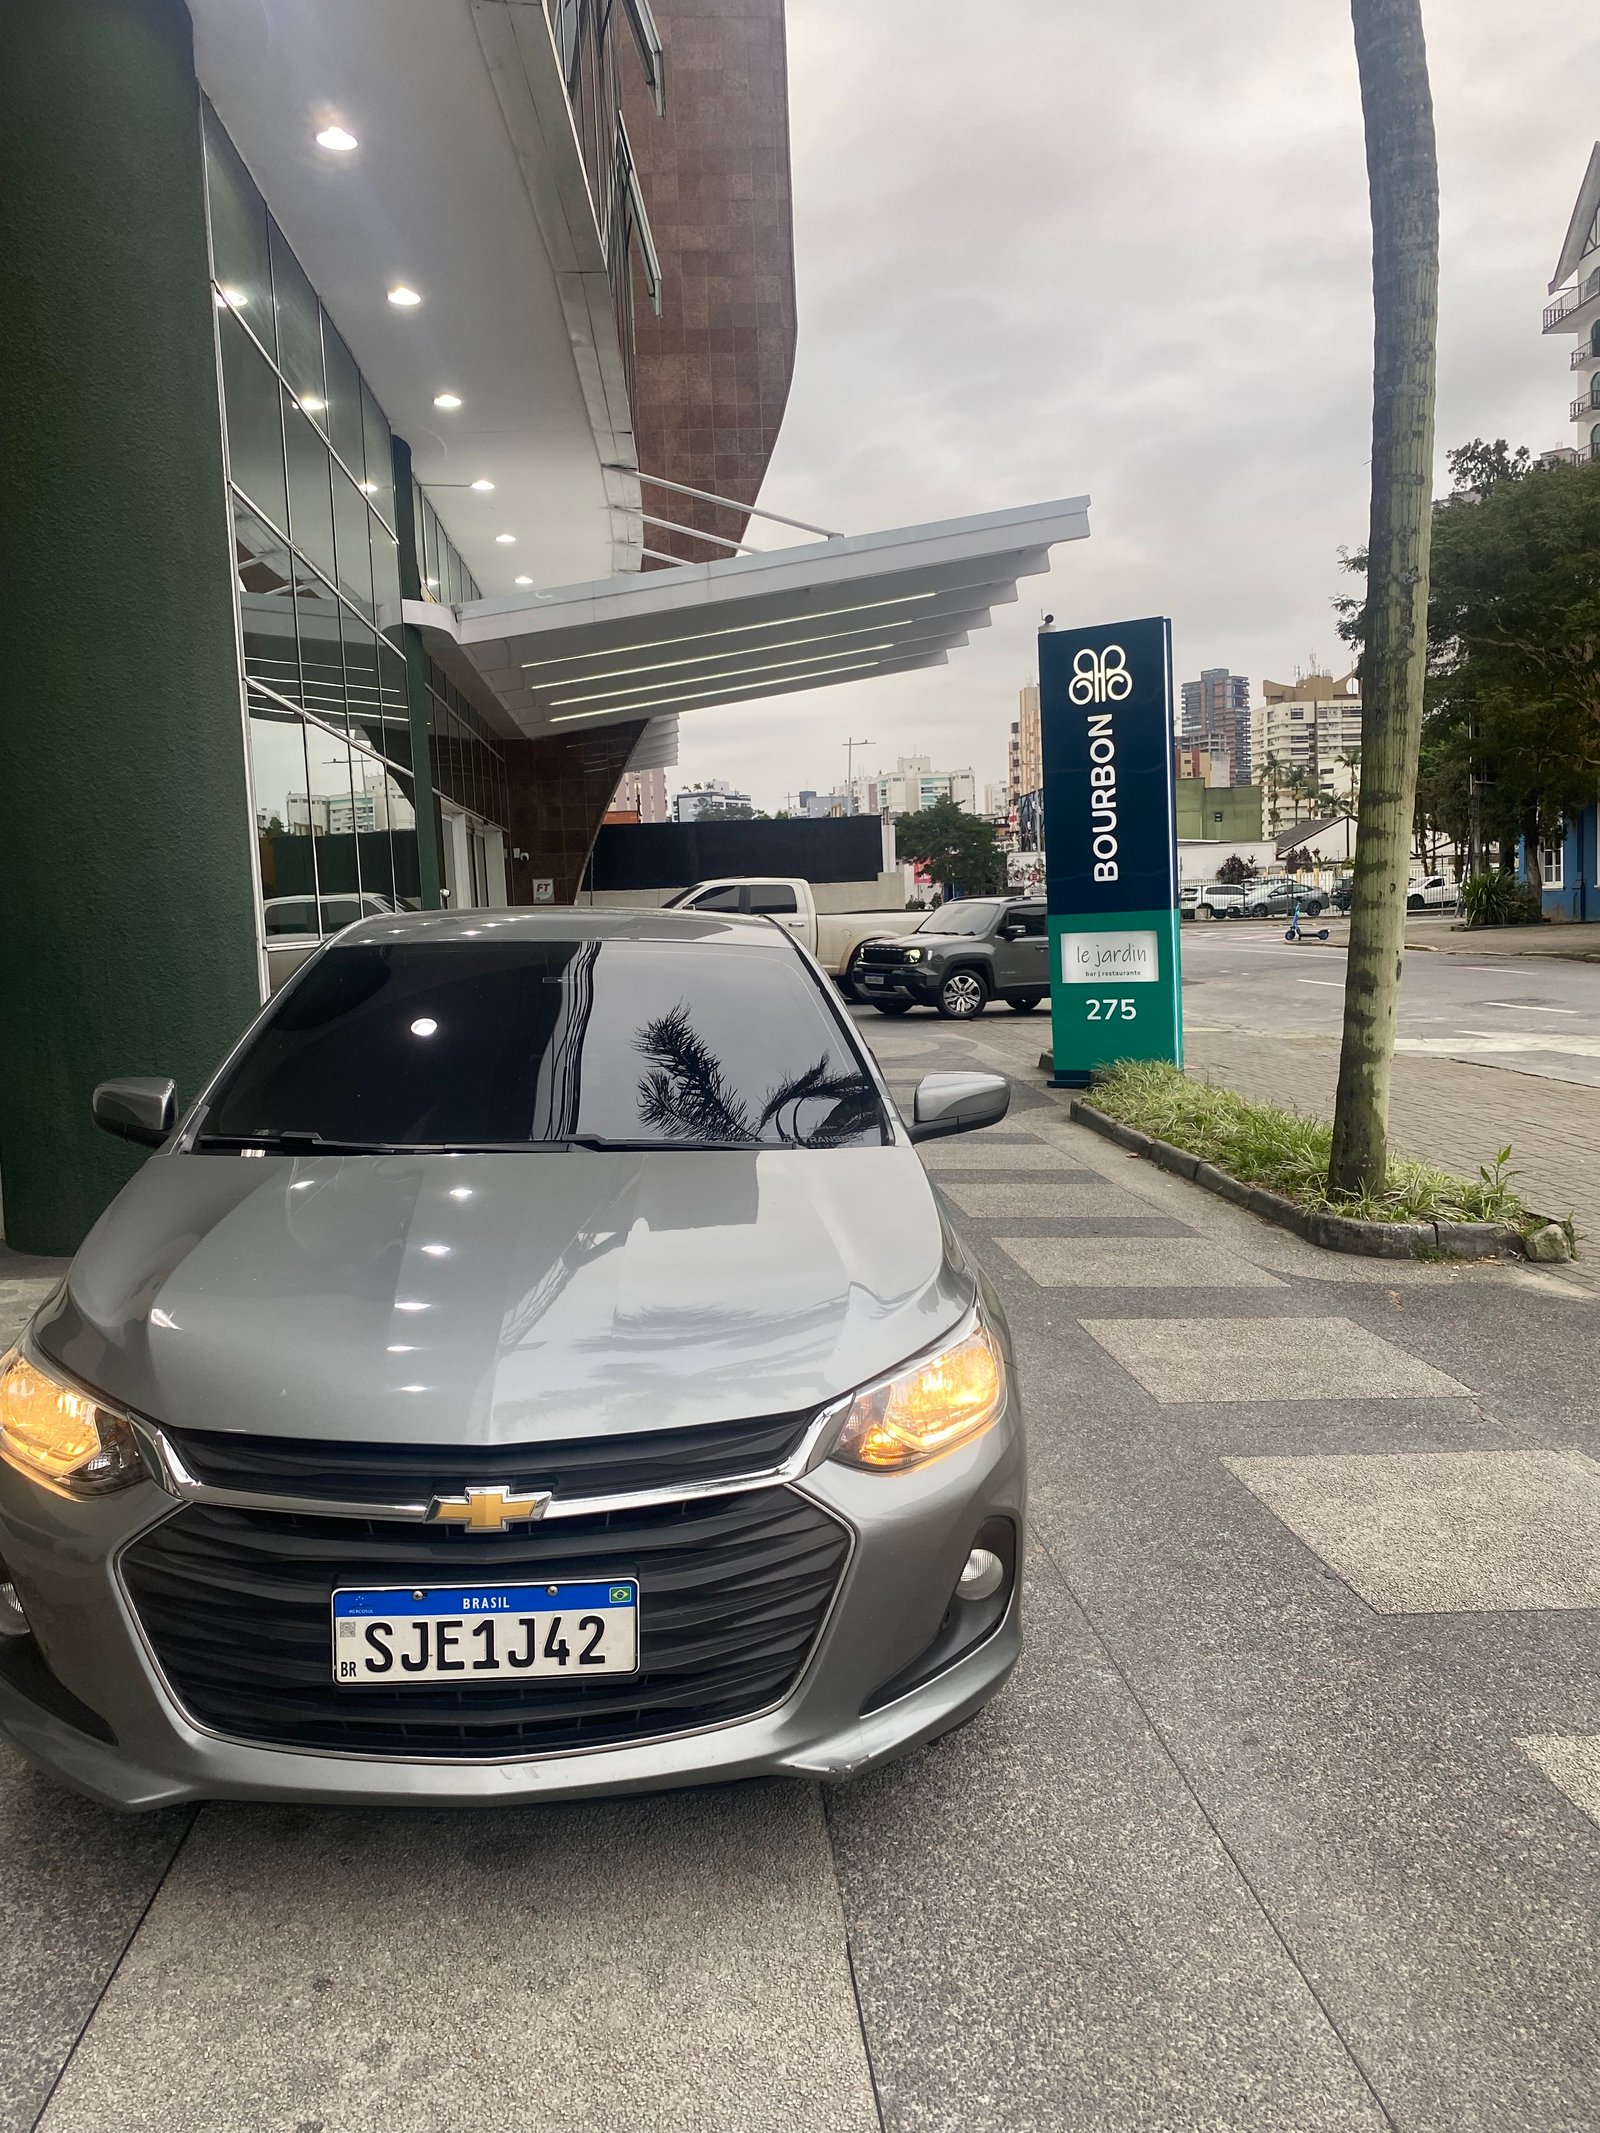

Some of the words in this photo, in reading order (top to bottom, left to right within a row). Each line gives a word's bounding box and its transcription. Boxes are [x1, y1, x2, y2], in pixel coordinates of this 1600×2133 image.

[1087, 713, 1119, 882] BOURBON
[537, 883, 551, 892] FT
[1076, 945, 1091, 963] le
[1094, 942, 1147, 968] jardin
[1085, 998, 1137, 1021] 275
[462, 1596, 511, 1610] BRASIL
[364, 1615, 606, 1673] SJE1J42
[340, 1661, 357, 1677] BR
